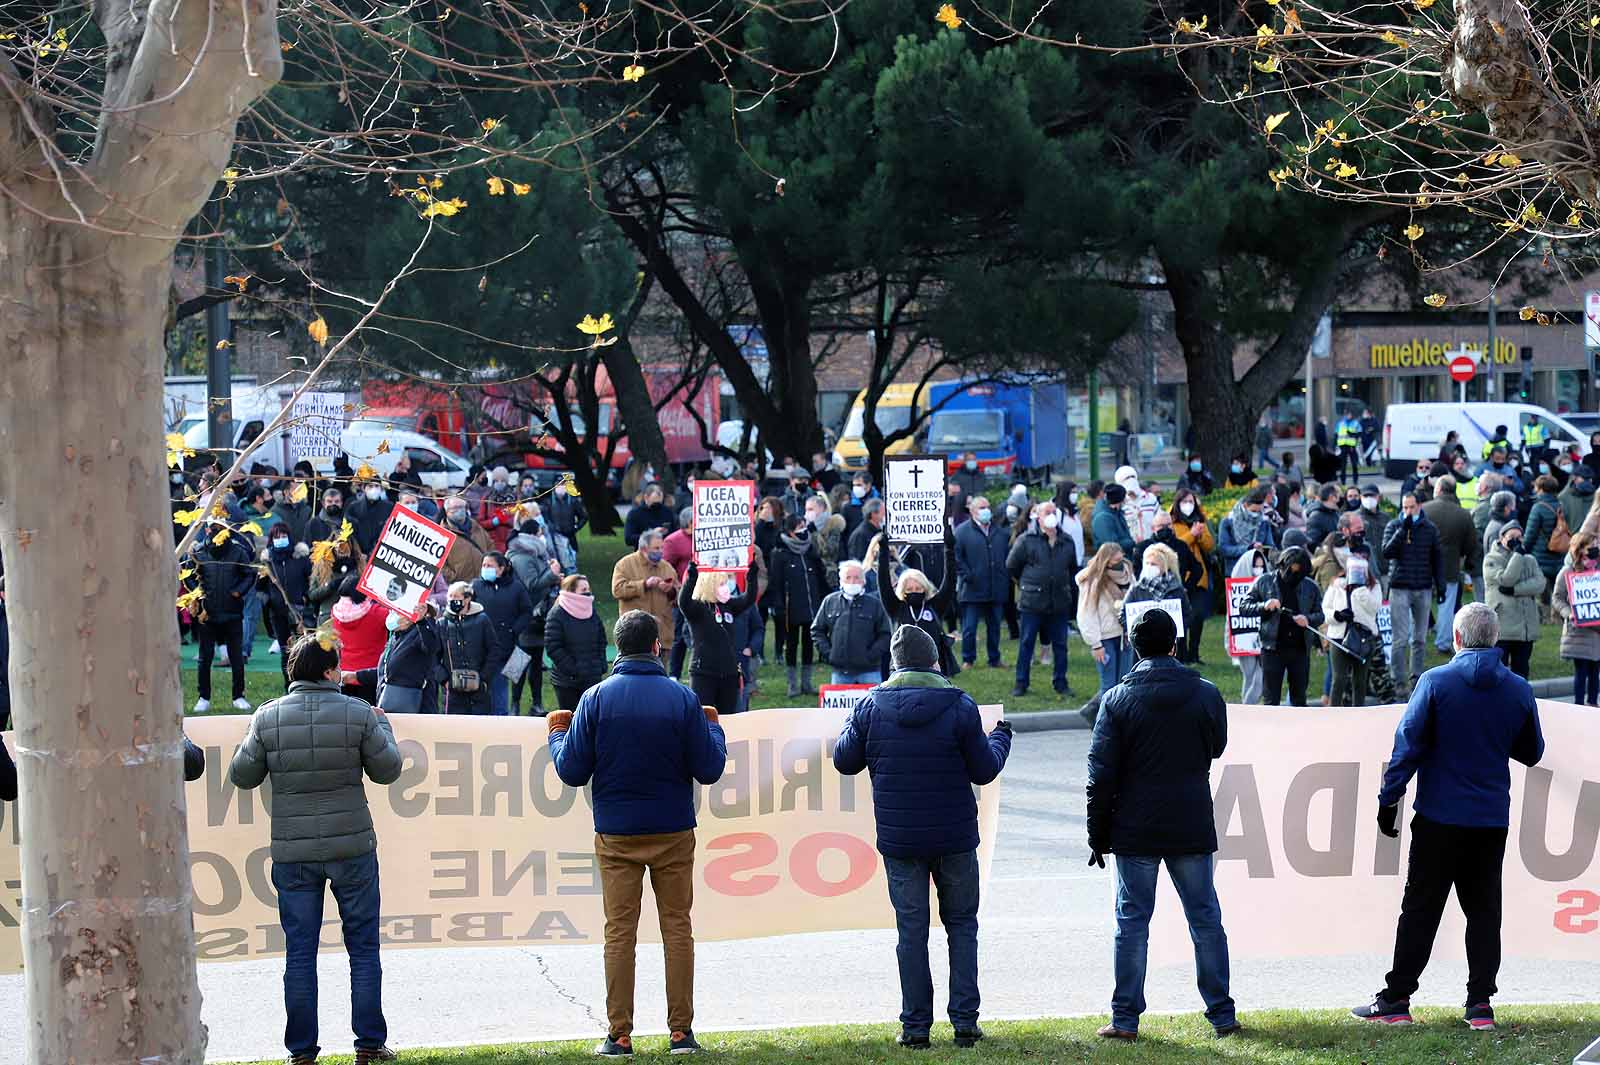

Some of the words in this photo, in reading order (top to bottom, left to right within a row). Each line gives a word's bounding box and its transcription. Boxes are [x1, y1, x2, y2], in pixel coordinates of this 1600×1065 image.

[1371, 338, 1453, 368] muebles
[312, 394, 325, 404] NO
[698, 502, 750, 517] CASADO
[892, 500, 941, 513] CIERRES,
[895, 515, 910, 523] NOS
[694, 526, 730, 541] MATAN
[738, 528, 751, 537] LOS
[891, 523, 942, 535] MATANDO
[388, 518, 446, 559] MAÑUECO
[695, 535, 752, 551] HOSTELEROS
[375, 545, 434, 586] DIMISIÓN
[1576, 587, 1599, 600] NOS
